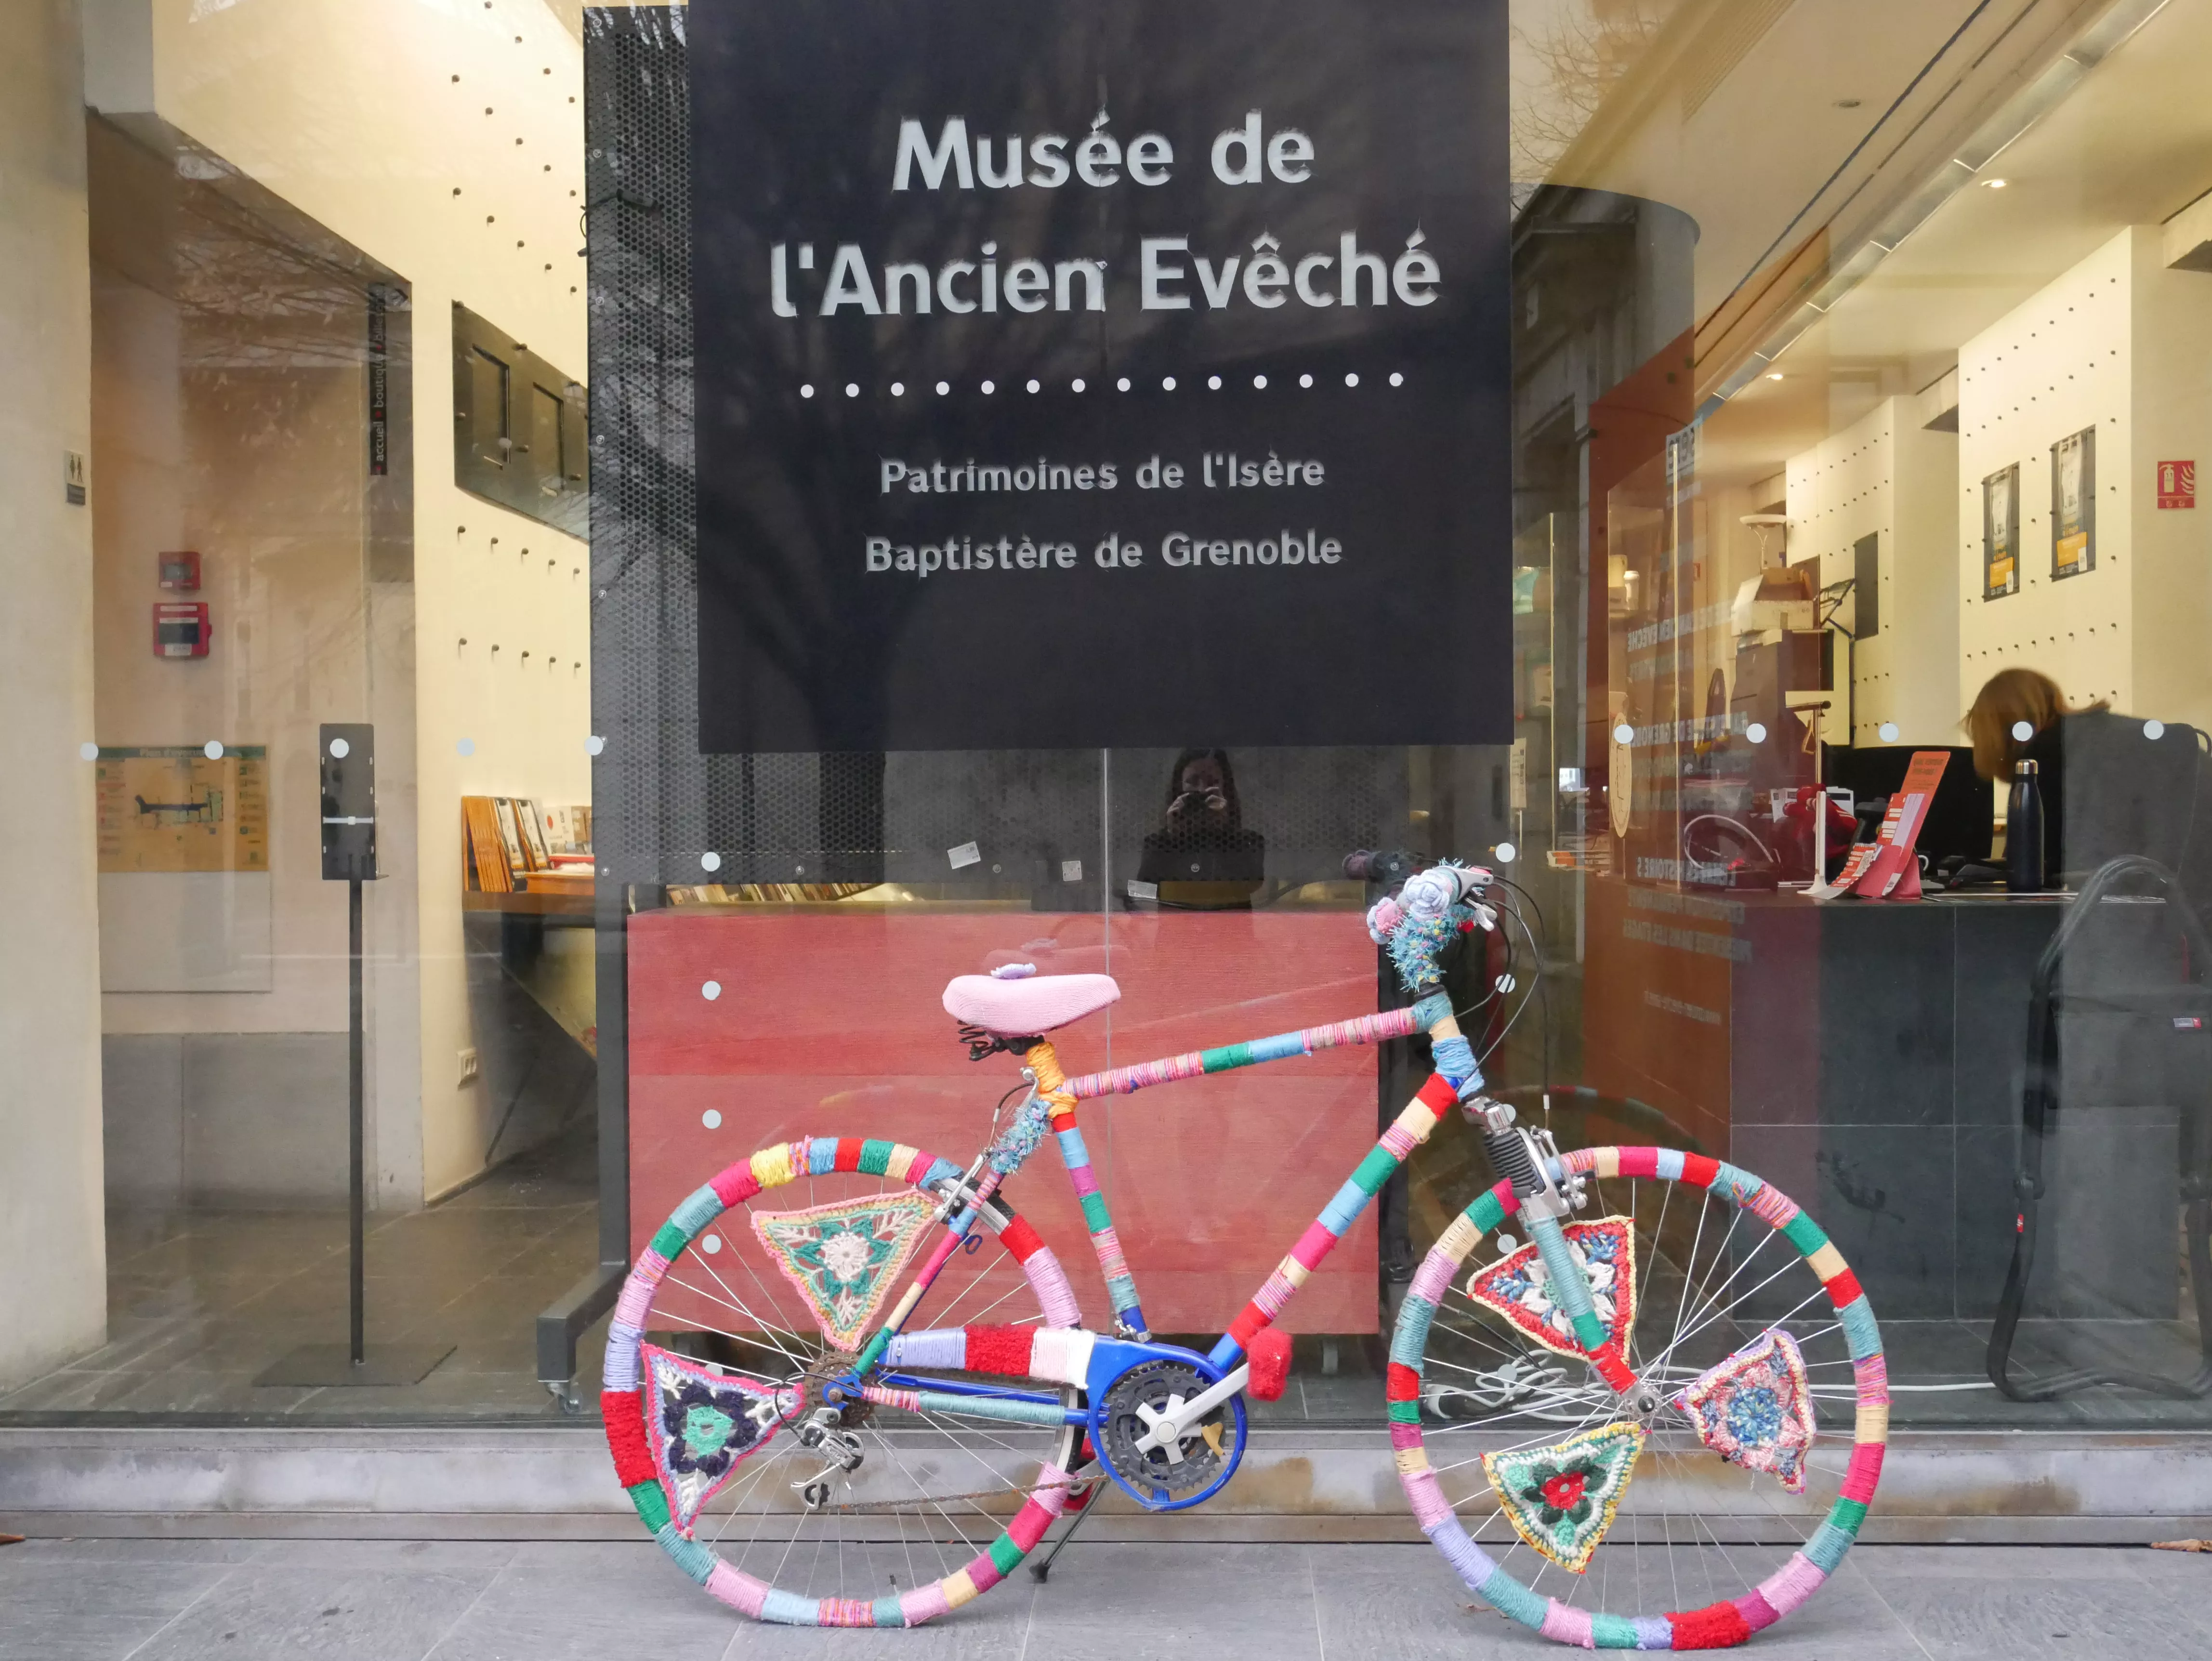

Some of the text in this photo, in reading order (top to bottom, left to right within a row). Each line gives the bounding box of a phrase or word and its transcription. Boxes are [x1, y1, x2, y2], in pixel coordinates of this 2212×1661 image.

[892, 109, 1315, 191] Musée de
[769, 227, 1441, 318] l'Ancien Evêché
[373, 353, 386, 408] boutique
[374, 421, 384, 461] accueil
[881, 451, 1325, 494] Patrimoines de l'Isère
[865, 529, 1343, 578] Baptistère de Grenoble
